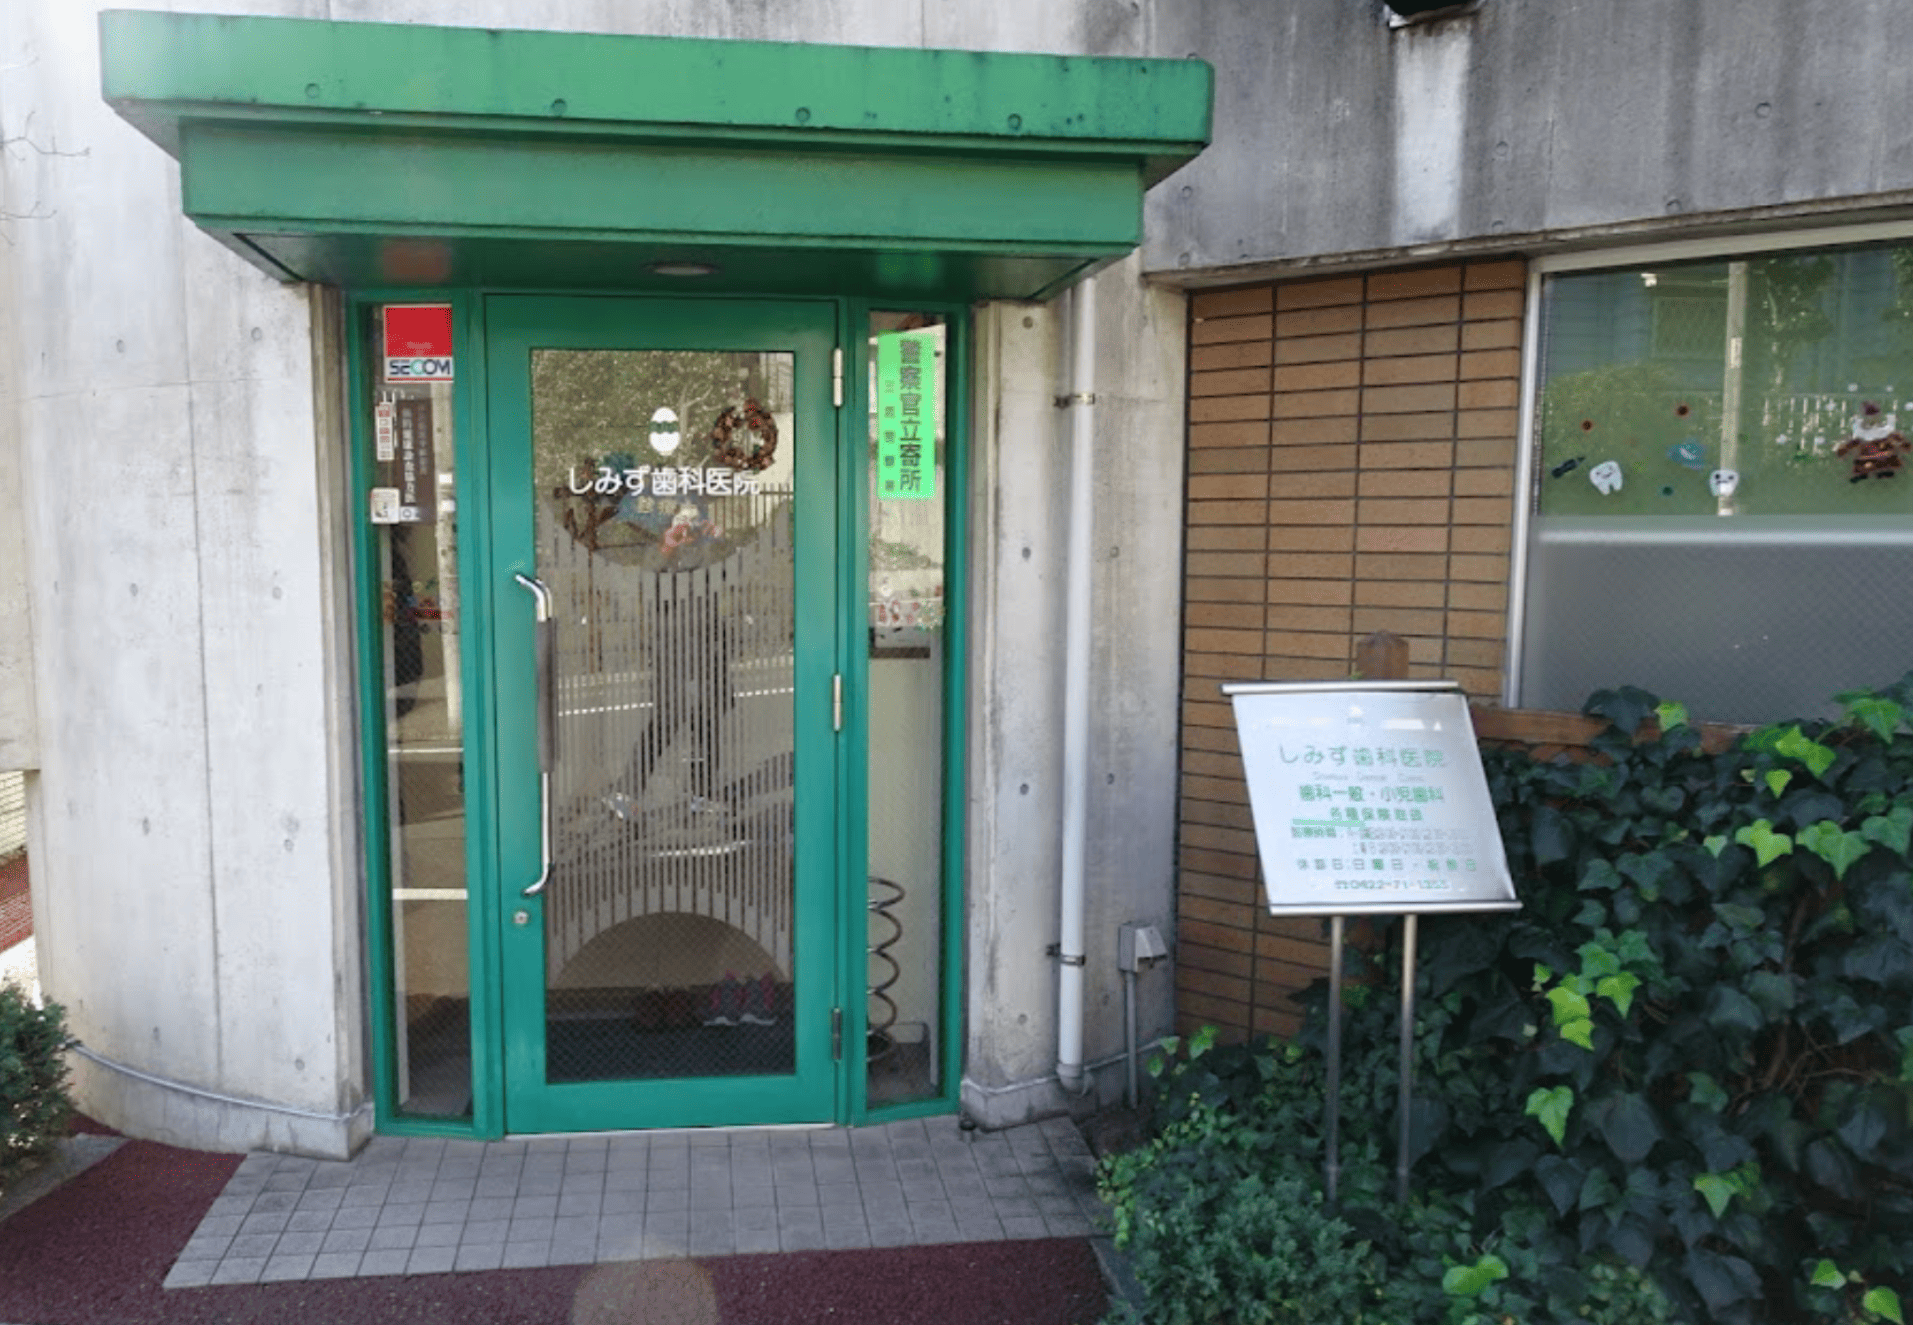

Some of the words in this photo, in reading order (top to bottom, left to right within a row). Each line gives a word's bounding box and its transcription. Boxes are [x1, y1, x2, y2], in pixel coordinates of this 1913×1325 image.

[389, 359, 451, 375] SECOM
[569, 464, 761, 496] しみず歯科医院
[1279, 744, 1448, 768] しみず歯科医院
